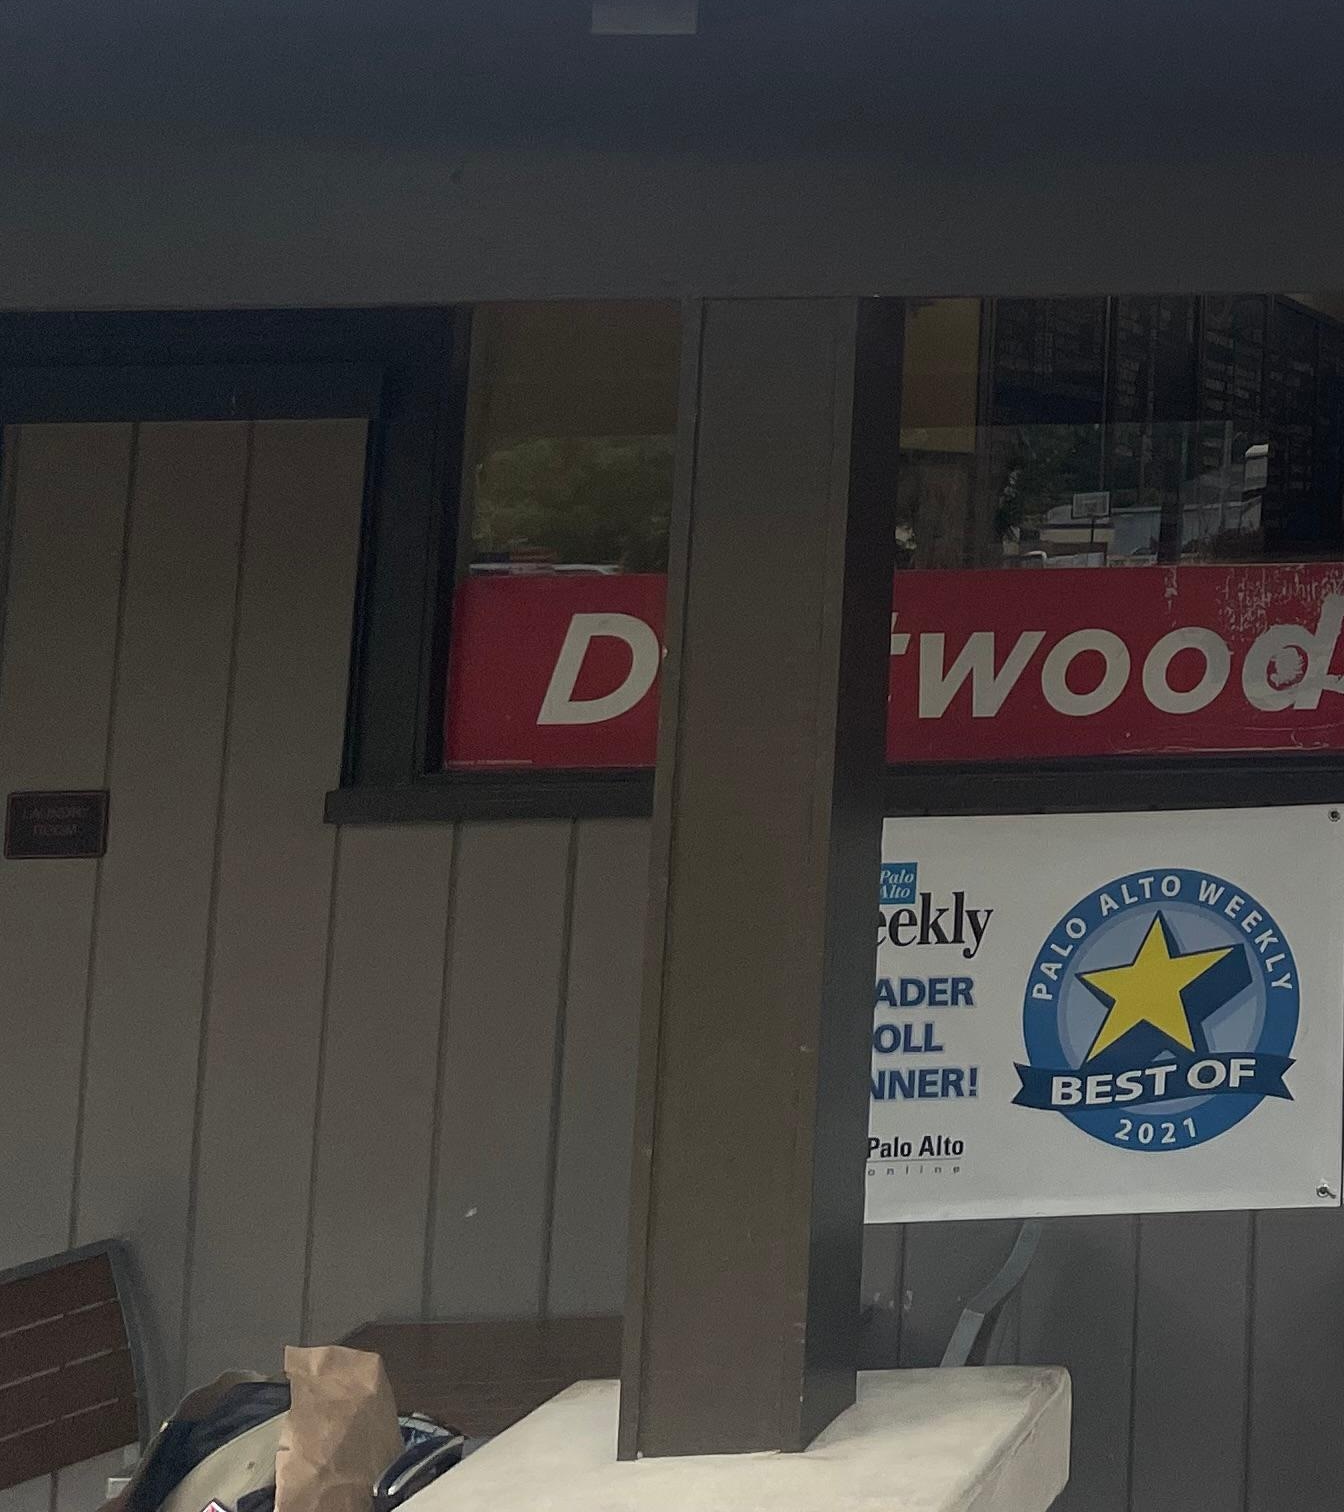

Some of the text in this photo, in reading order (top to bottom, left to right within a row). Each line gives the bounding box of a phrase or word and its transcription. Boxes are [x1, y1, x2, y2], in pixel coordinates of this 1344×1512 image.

[880, 869, 915, 884] Palo
[877, 891, 994, 959] ekly
[1033, 875, 1293, 1000] PALO ALTO WEEKLY
[875, 976, 974, 1007] ADER
[872, 1023, 943, 1054] OLL
[871, 1067, 978, 1100] NNER!
[1050, 1059, 1256, 1106] BEST OF
[868, 1135, 964, 1158] Palo Alto
[1114, 1119, 1197, 1144] 2021
